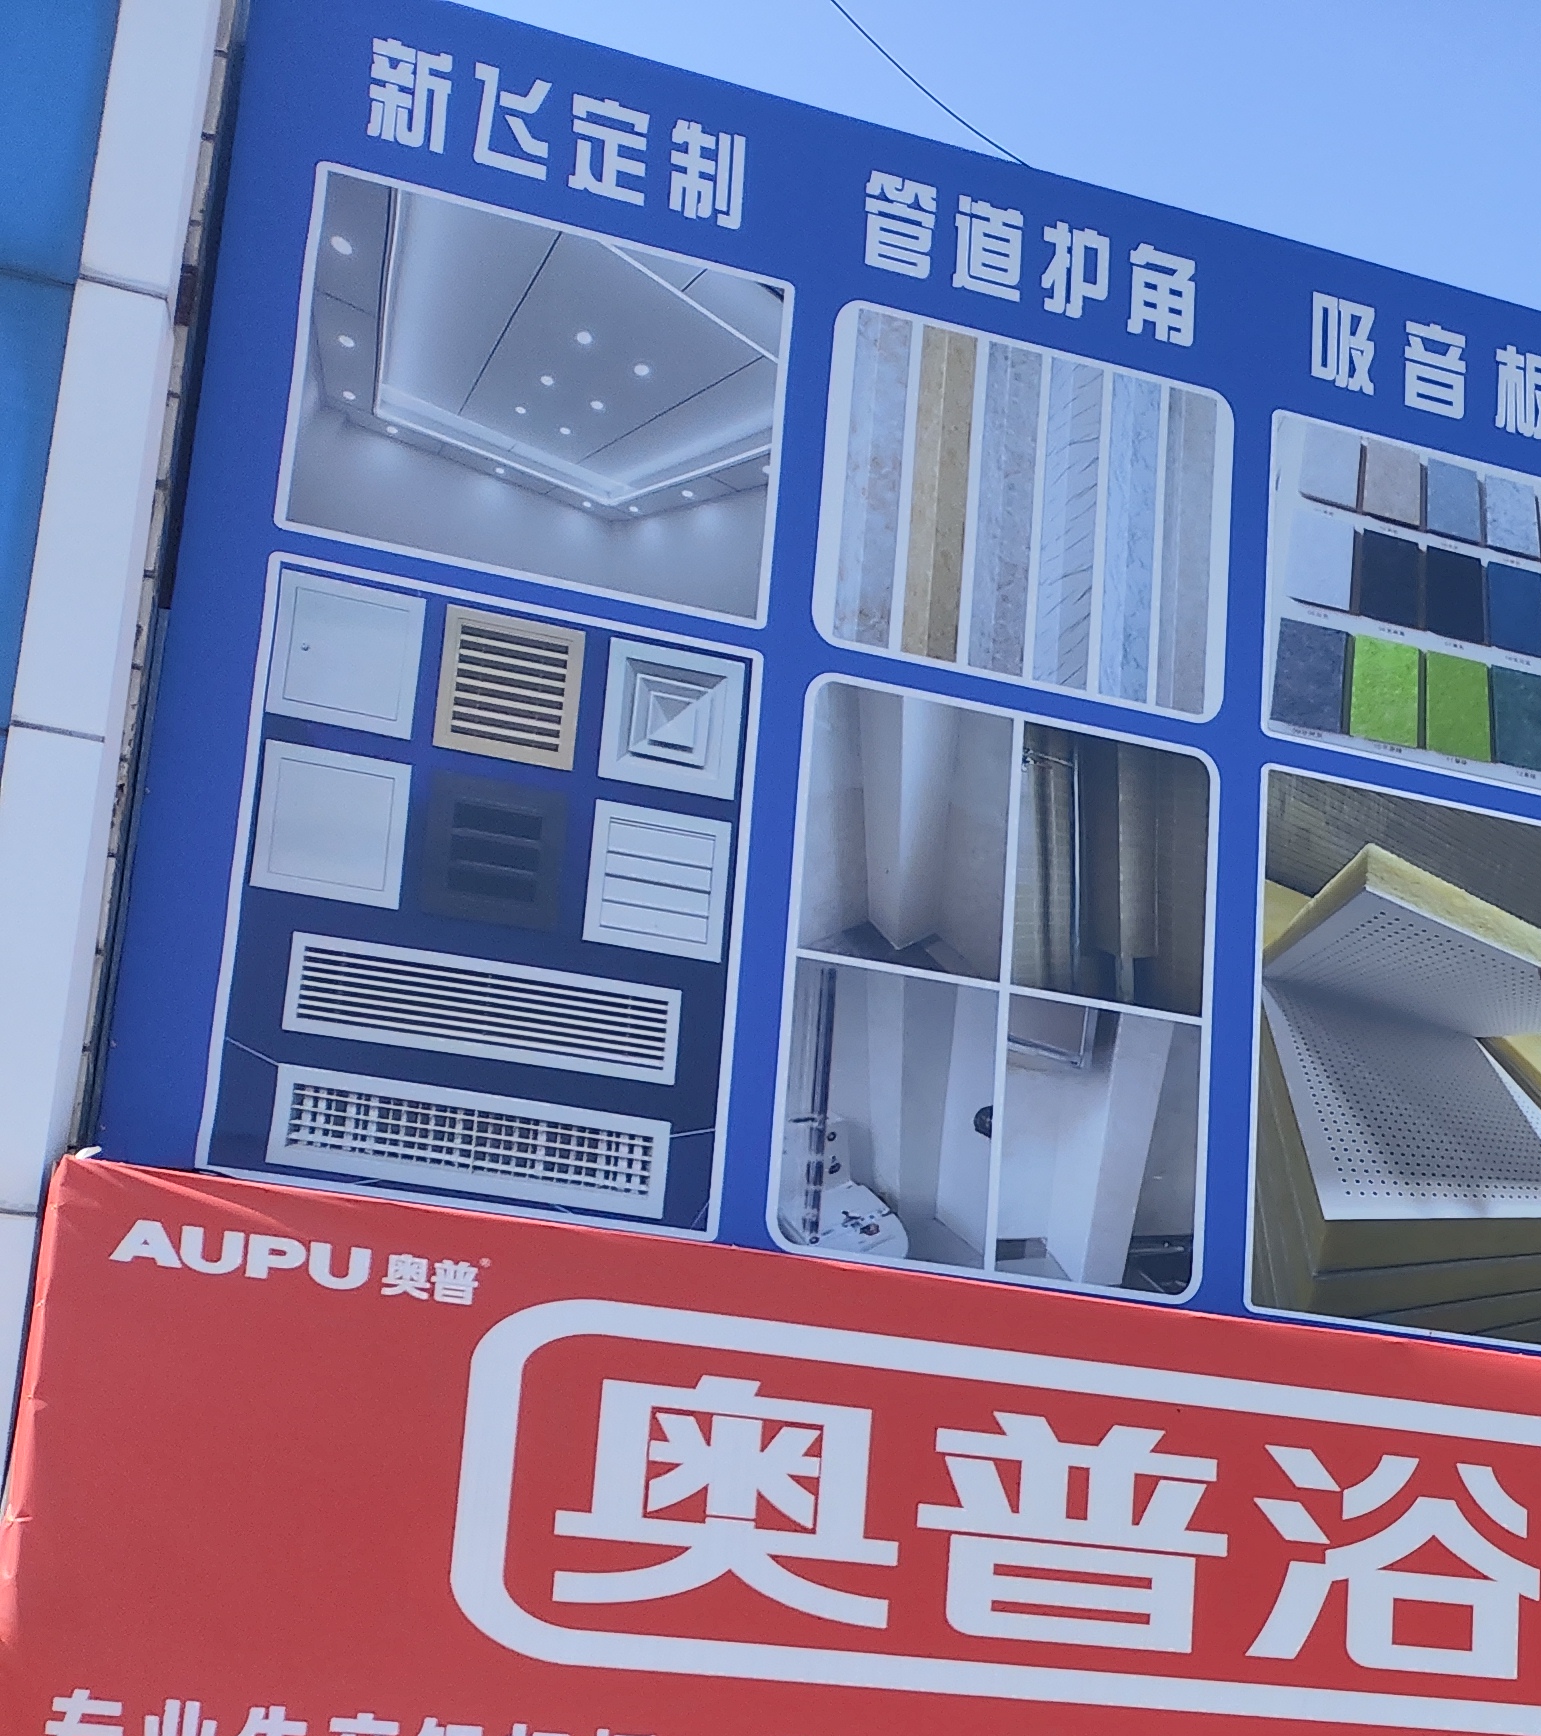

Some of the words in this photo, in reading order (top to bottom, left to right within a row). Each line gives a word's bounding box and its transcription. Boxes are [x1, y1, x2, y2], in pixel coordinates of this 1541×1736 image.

[367, 37, 747, 229] 新飞定制
[864, 169, 1196, 347] 管道护角
[109, 1217, 371, 1293] AUPU
[380, 1252, 480, 1305] 奥普
